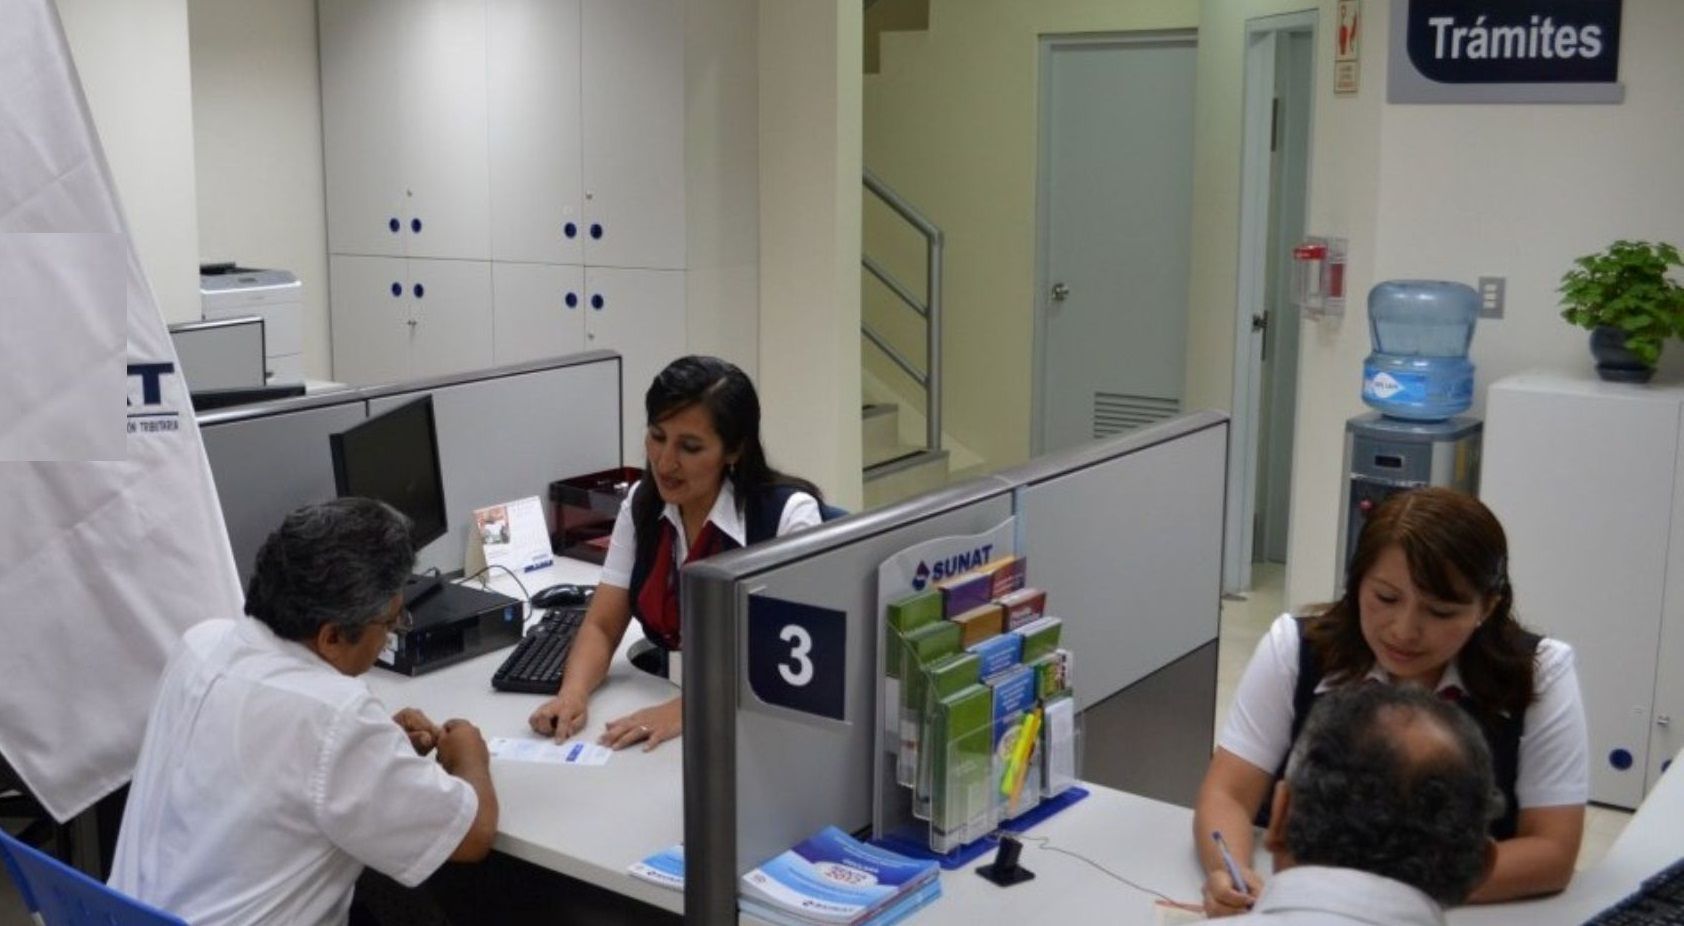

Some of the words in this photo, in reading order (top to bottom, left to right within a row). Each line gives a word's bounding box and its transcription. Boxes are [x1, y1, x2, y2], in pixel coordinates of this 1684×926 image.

[1428, 15, 1602, 59] Trámites
[932, 543, 994, 582] SUNAT
[778, 624, 814, 687] 3
